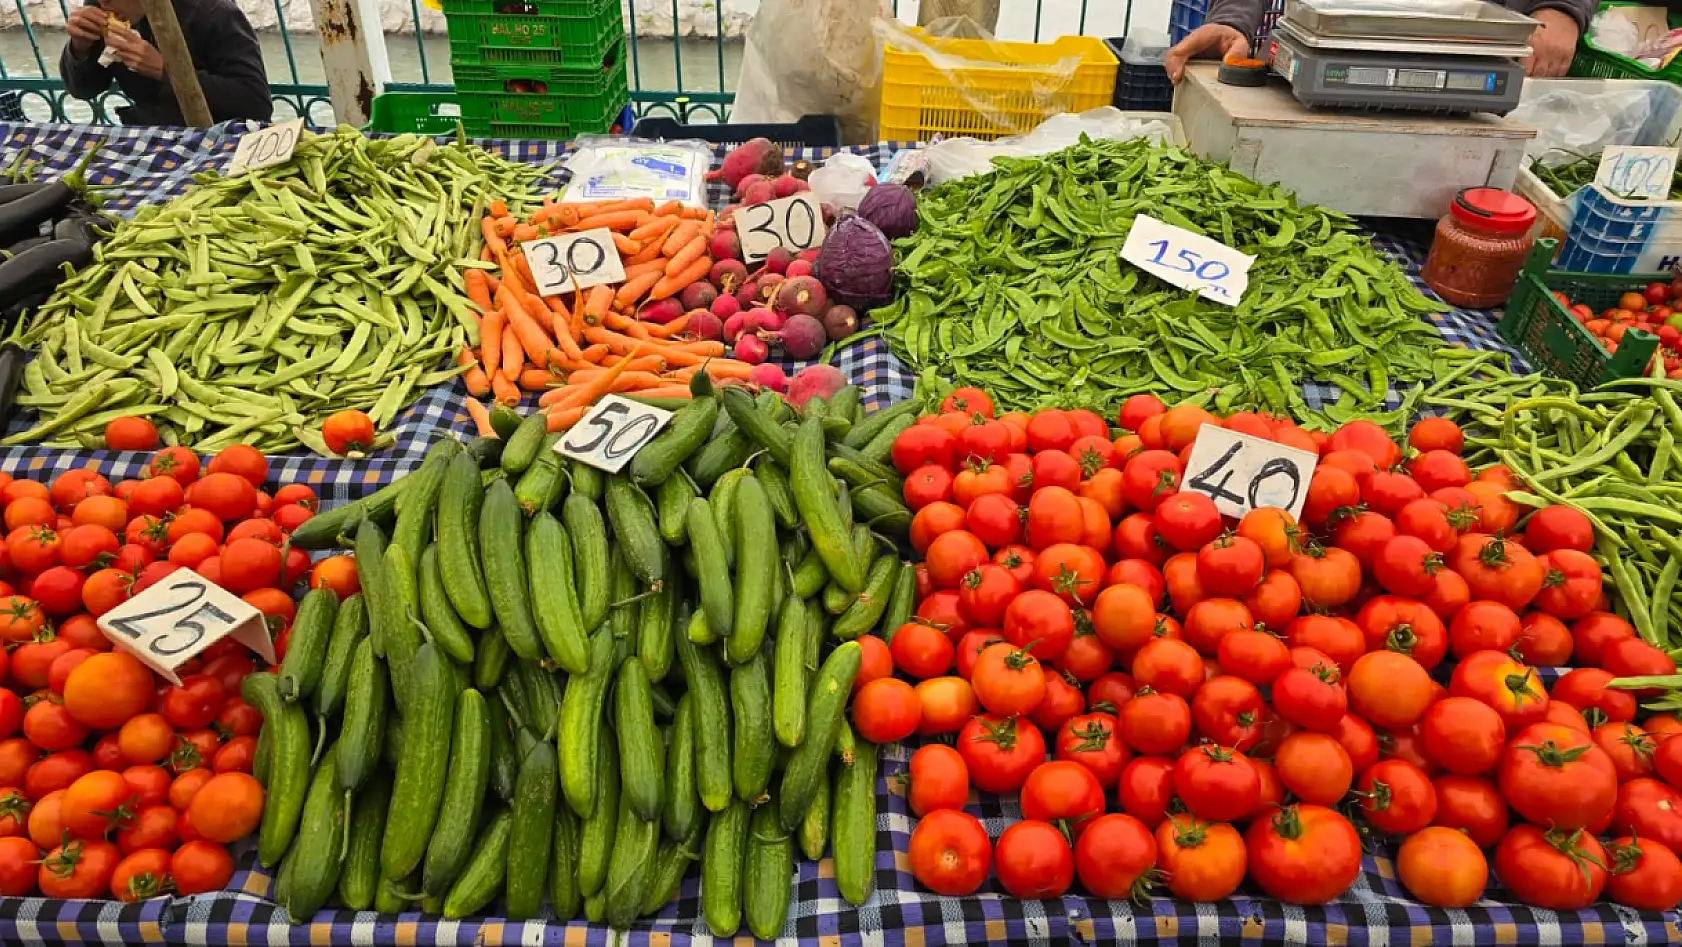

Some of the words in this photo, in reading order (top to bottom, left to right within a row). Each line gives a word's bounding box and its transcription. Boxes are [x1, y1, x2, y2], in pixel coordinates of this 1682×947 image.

[245, 128, 294, 166] 100
[1606, 152, 1672, 194] 100
[748, 198, 816, 259] 30
[531, 237, 606, 288] 30
[1145, 240, 1230, 281] 150
[564, 402, 660, 459] 50
[1188, 441, 1301, 512] 40
[108, 581, 237, 656] 25
